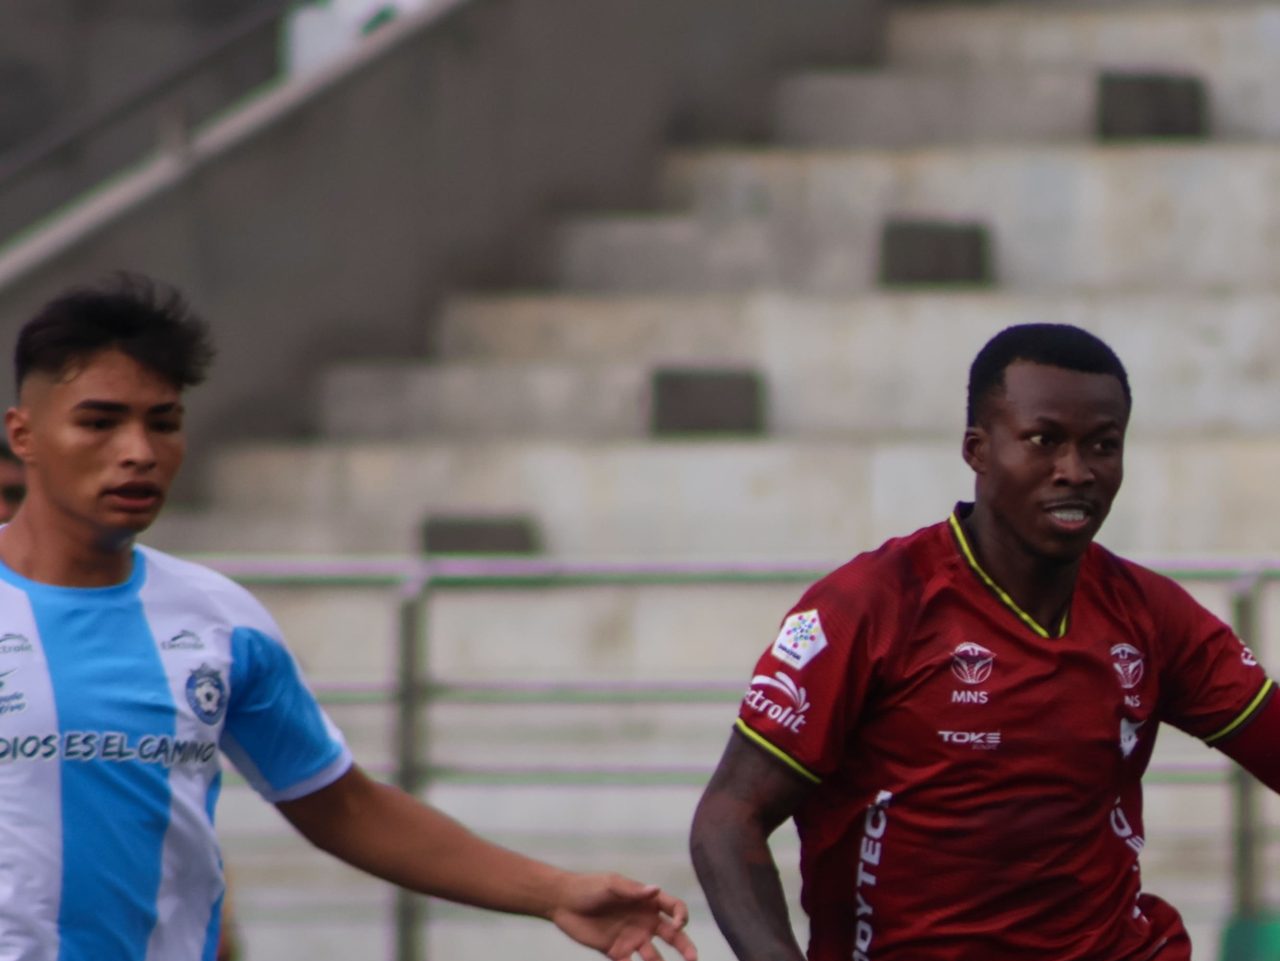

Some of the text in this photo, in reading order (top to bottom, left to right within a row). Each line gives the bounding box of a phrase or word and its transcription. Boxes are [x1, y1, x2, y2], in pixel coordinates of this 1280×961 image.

[951, 690, 989, 705] MNS
[744, 688, 806, 733] ctrolit
[64, 733, 98, 758] ES
[102, 735, 135, 759] EL
[937, 730, 1001, 744] TOKE
